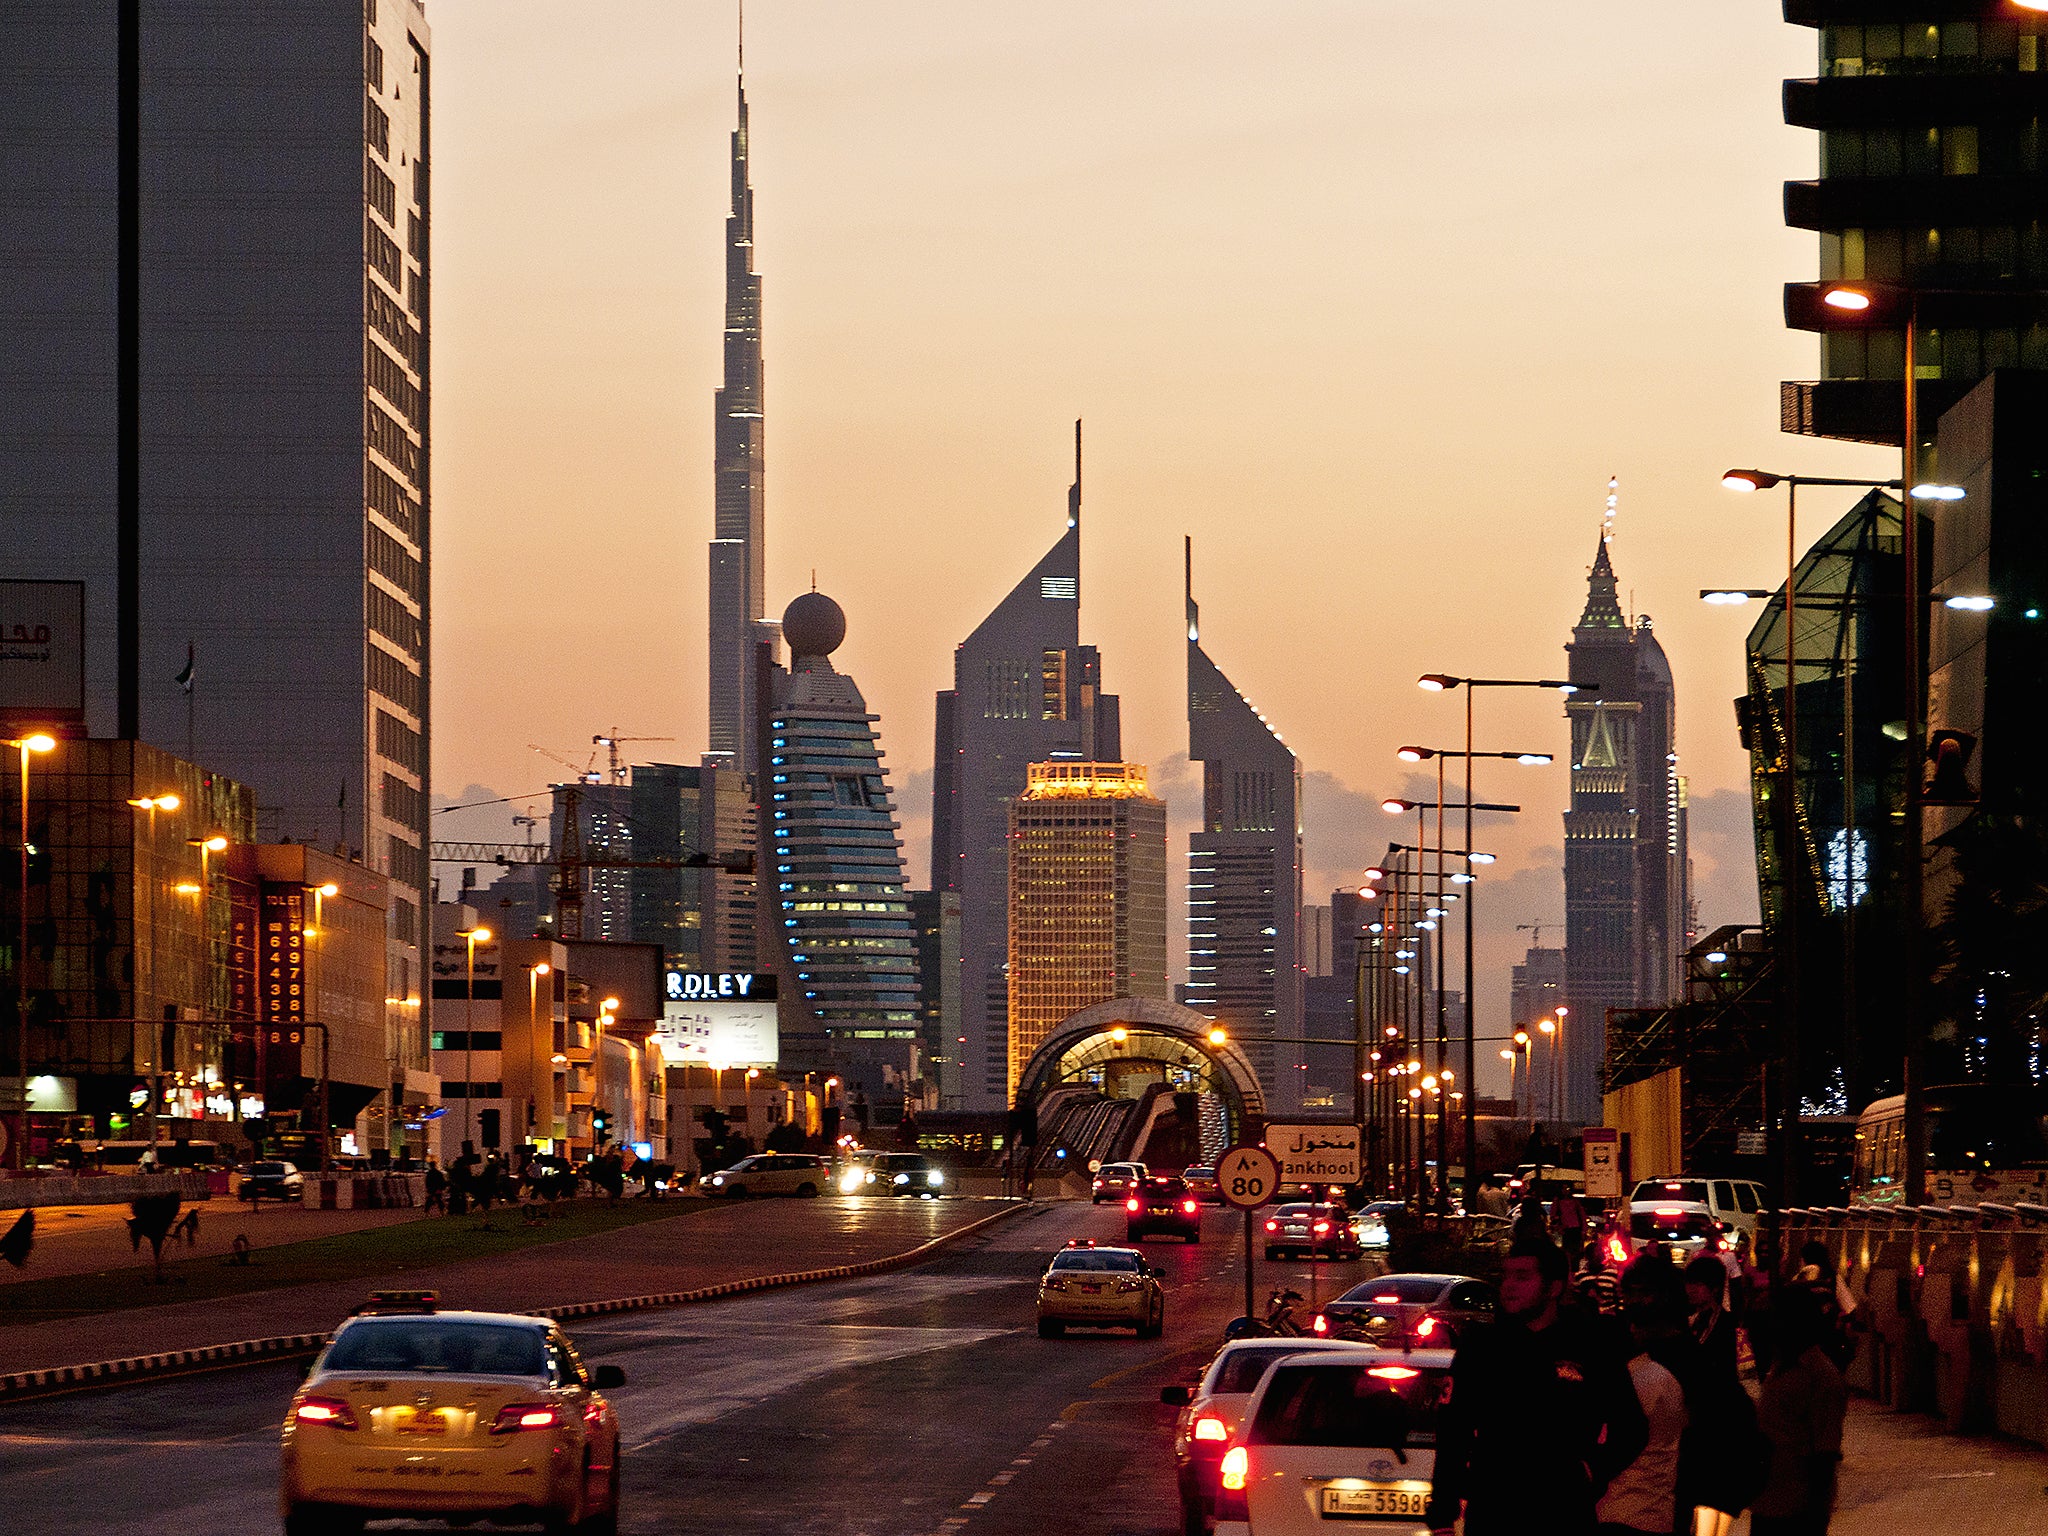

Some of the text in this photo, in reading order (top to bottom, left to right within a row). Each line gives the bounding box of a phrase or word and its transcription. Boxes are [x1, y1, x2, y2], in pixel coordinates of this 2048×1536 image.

[666, 972, 752, 996] RDLEY
[1290, 1133, 1356, 1153] منخول
[1231, 1177, 1263, 1197] 80
[1329, 1492, 1340, 1511] H
